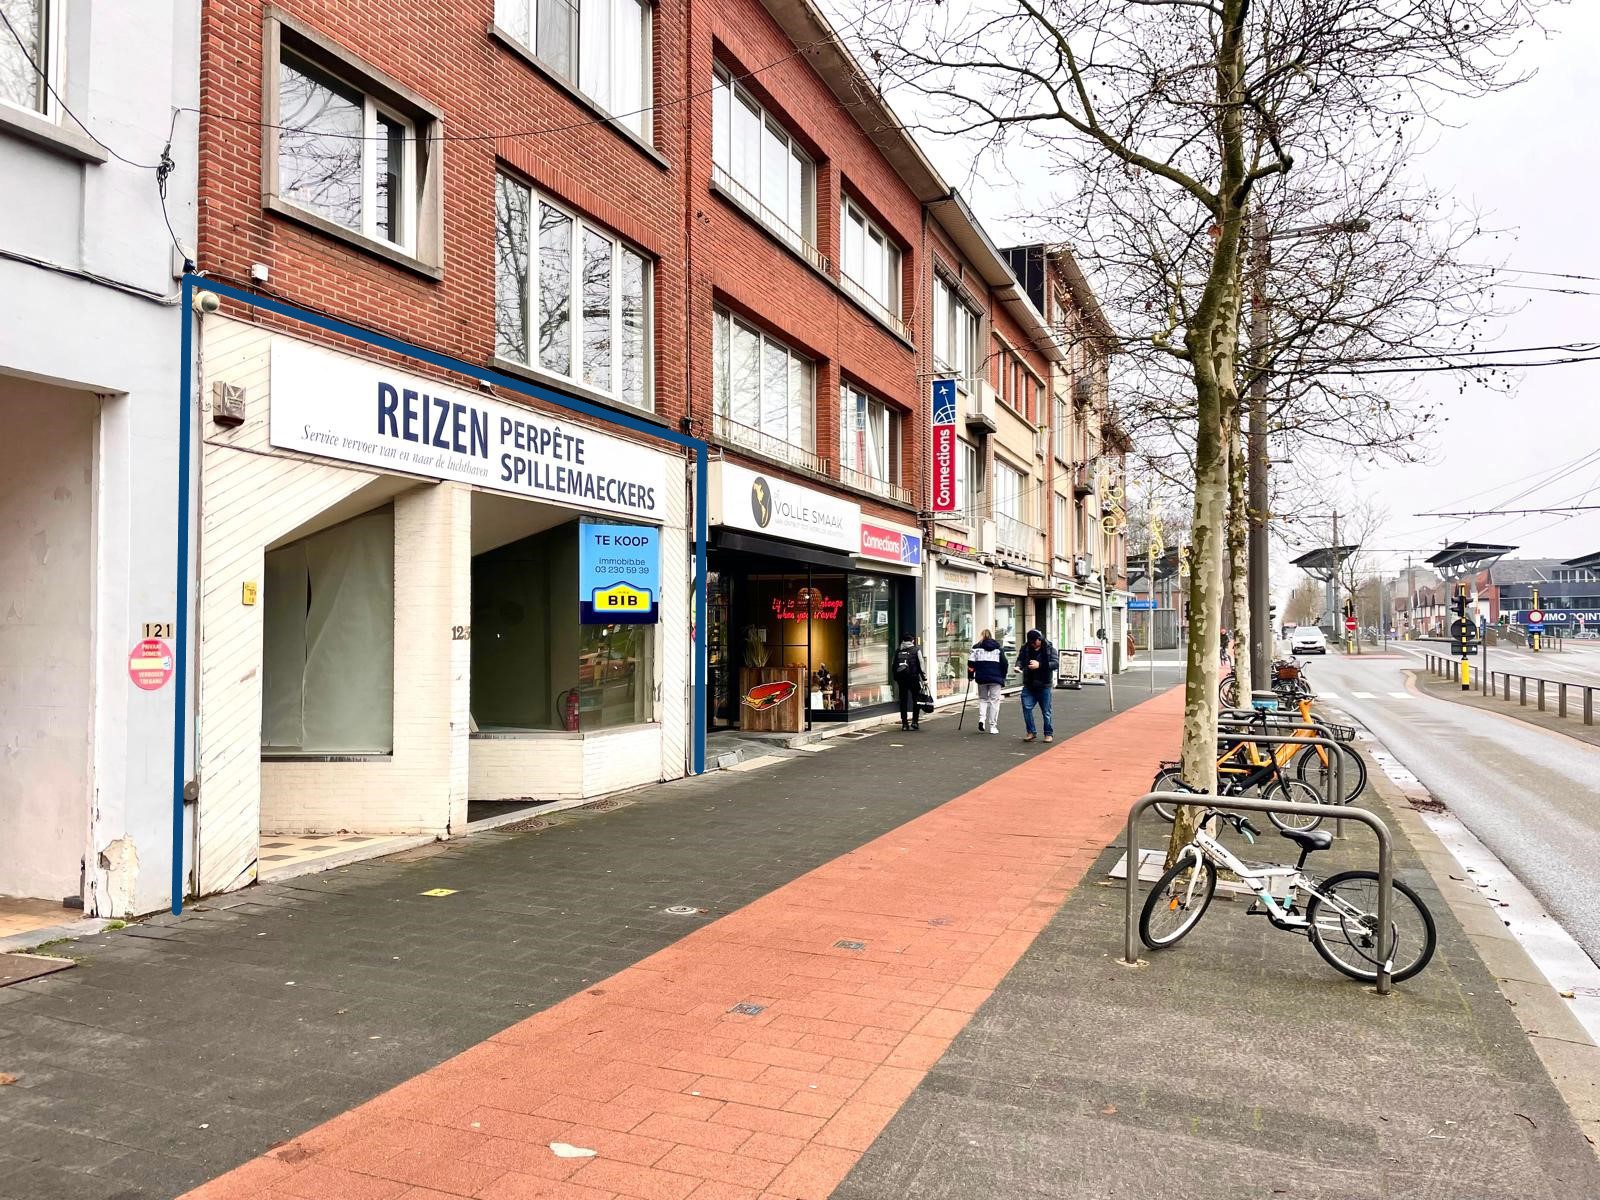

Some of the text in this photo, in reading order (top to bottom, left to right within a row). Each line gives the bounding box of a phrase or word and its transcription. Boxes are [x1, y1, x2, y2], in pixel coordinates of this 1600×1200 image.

[377, 381, 489, 460] REIZEN
[301, 424, 489, 478] Service vervoer van en naar de luchthaven
[500, 416, 585, 465] PERPÊTE
[936, 428, 951, 507] Connections
[500, 453, 656, 511] SPILLEMAECKERS
[773, 501, 809, 523] VOLLE
[812, 510, 844, 530] SMAAK
[595, 535, 649, 547] TE KOOP
[863, 531, 900, 554] Connections
[595, 566, 650, 575] 03 230 59 39
[608, 595, 638, 606] BIB
[1542, 612, 1567, 621] MMO
[145, 623, 170, 638] 121
